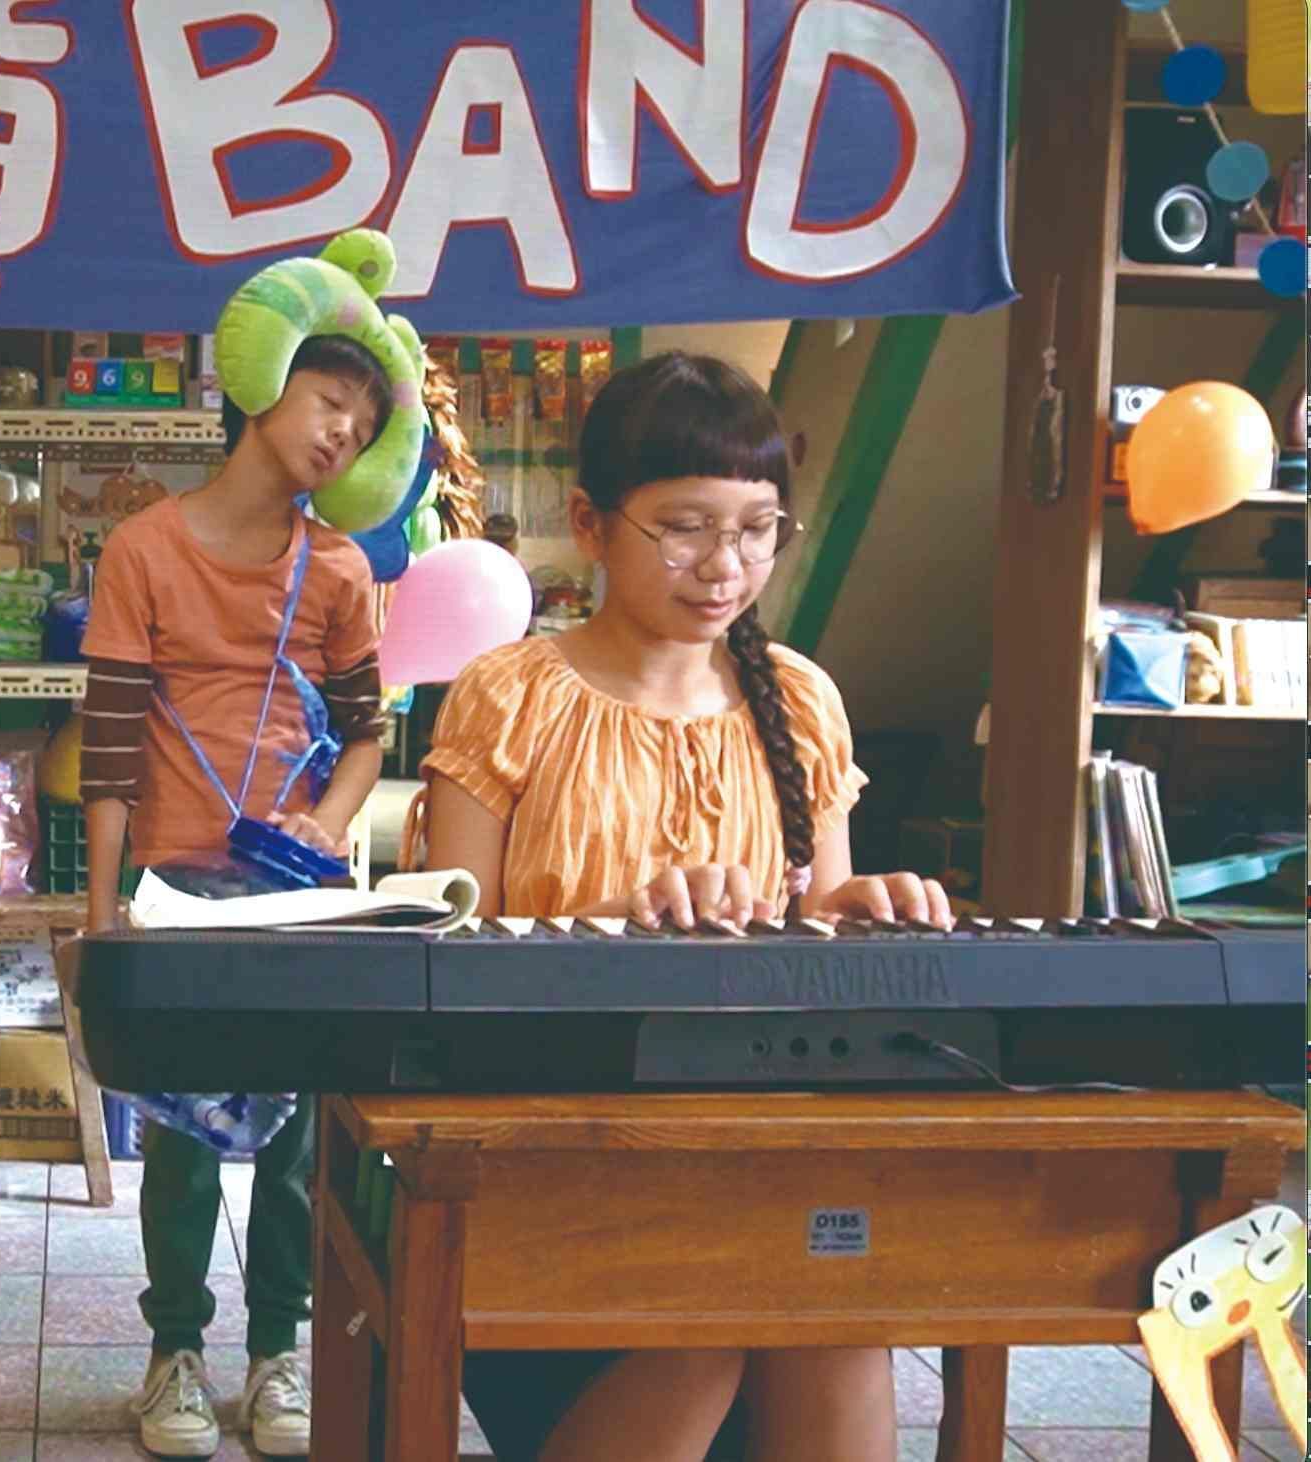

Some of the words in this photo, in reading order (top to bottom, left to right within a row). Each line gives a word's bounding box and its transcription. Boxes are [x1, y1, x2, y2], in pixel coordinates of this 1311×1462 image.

[125, 0, 971, 298] BAND
[73, 370, 87, 386] 9
[102, 369, 116, 386] 6
[780, 952, 950, 1002] YAMAHA
